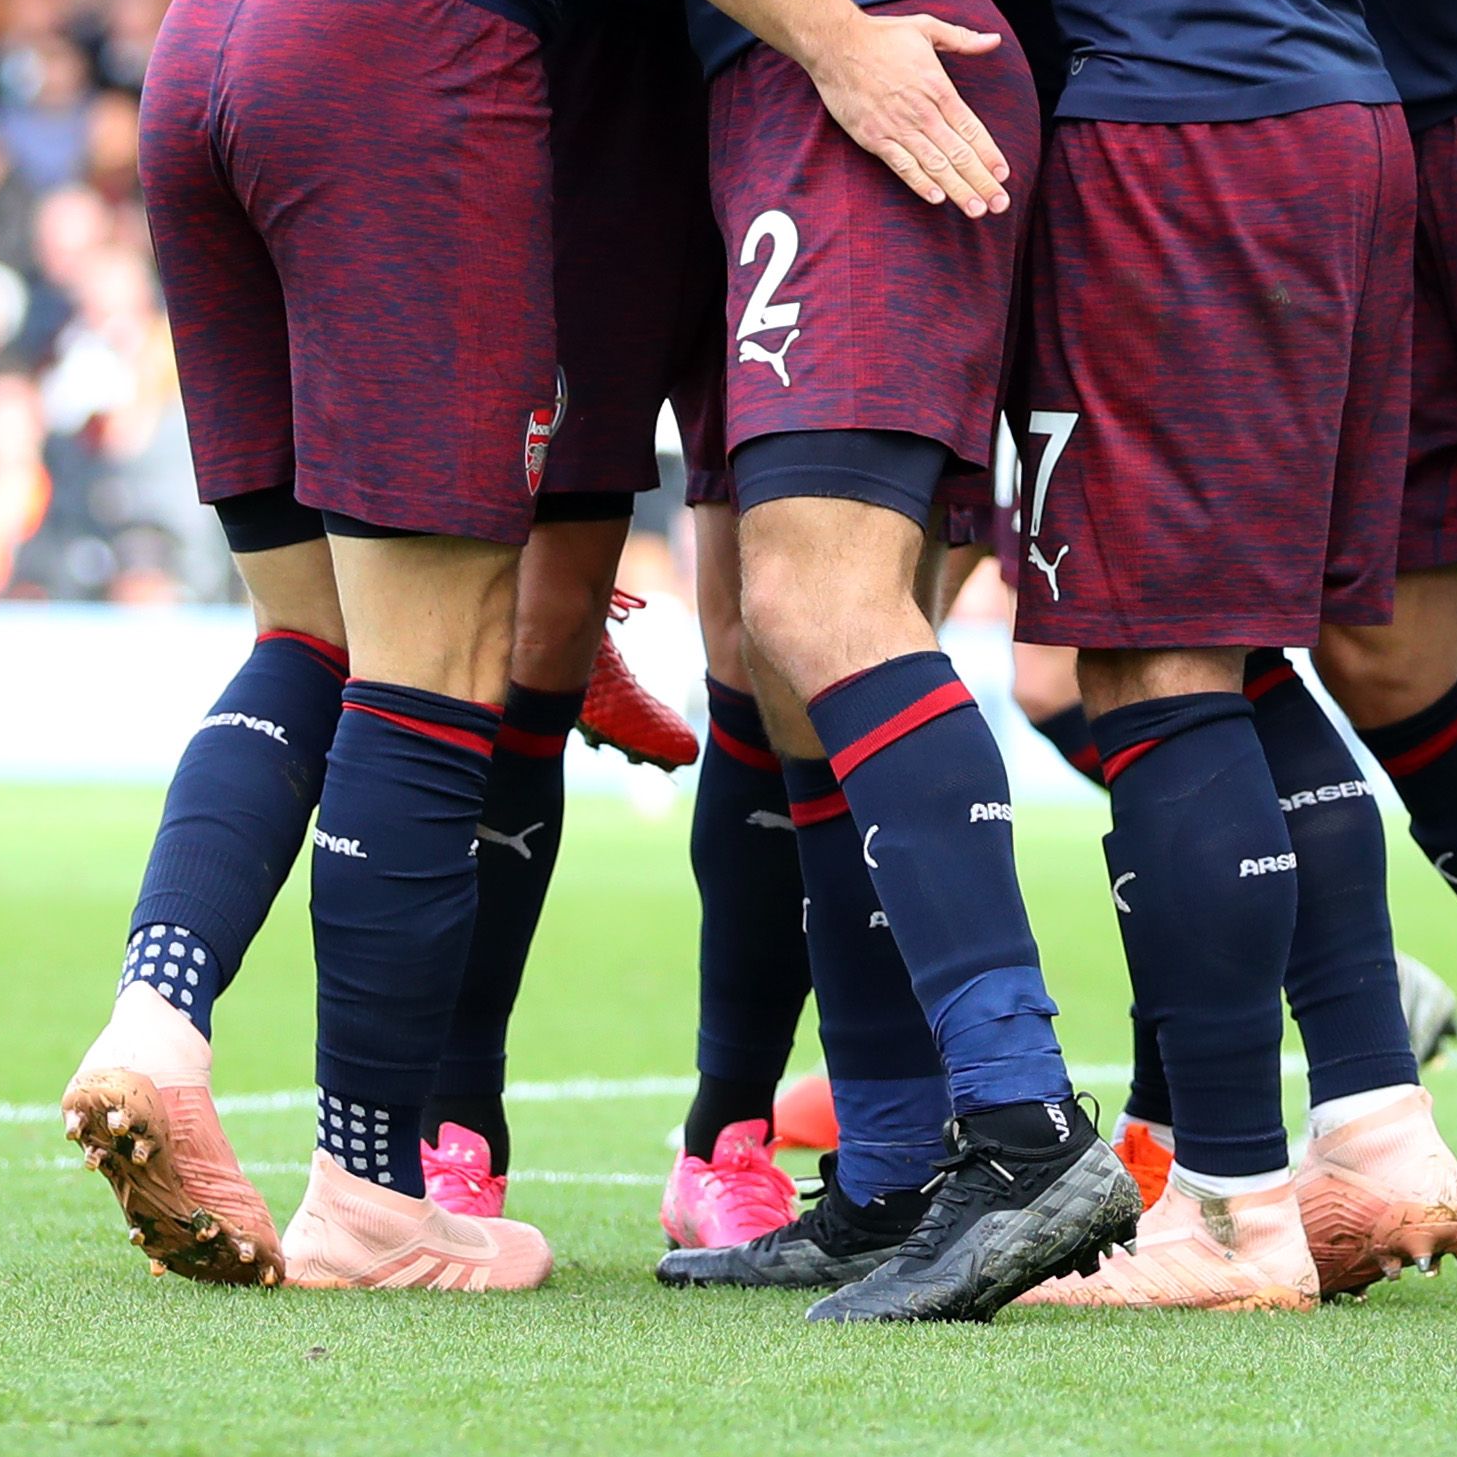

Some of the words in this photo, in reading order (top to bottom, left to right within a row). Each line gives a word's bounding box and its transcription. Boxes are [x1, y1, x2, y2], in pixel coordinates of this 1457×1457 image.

[736, 209, 802, 341] 2
[969, 801, 1014, 823] ARS
[1278, 779, 1374, 812] ARSEN
